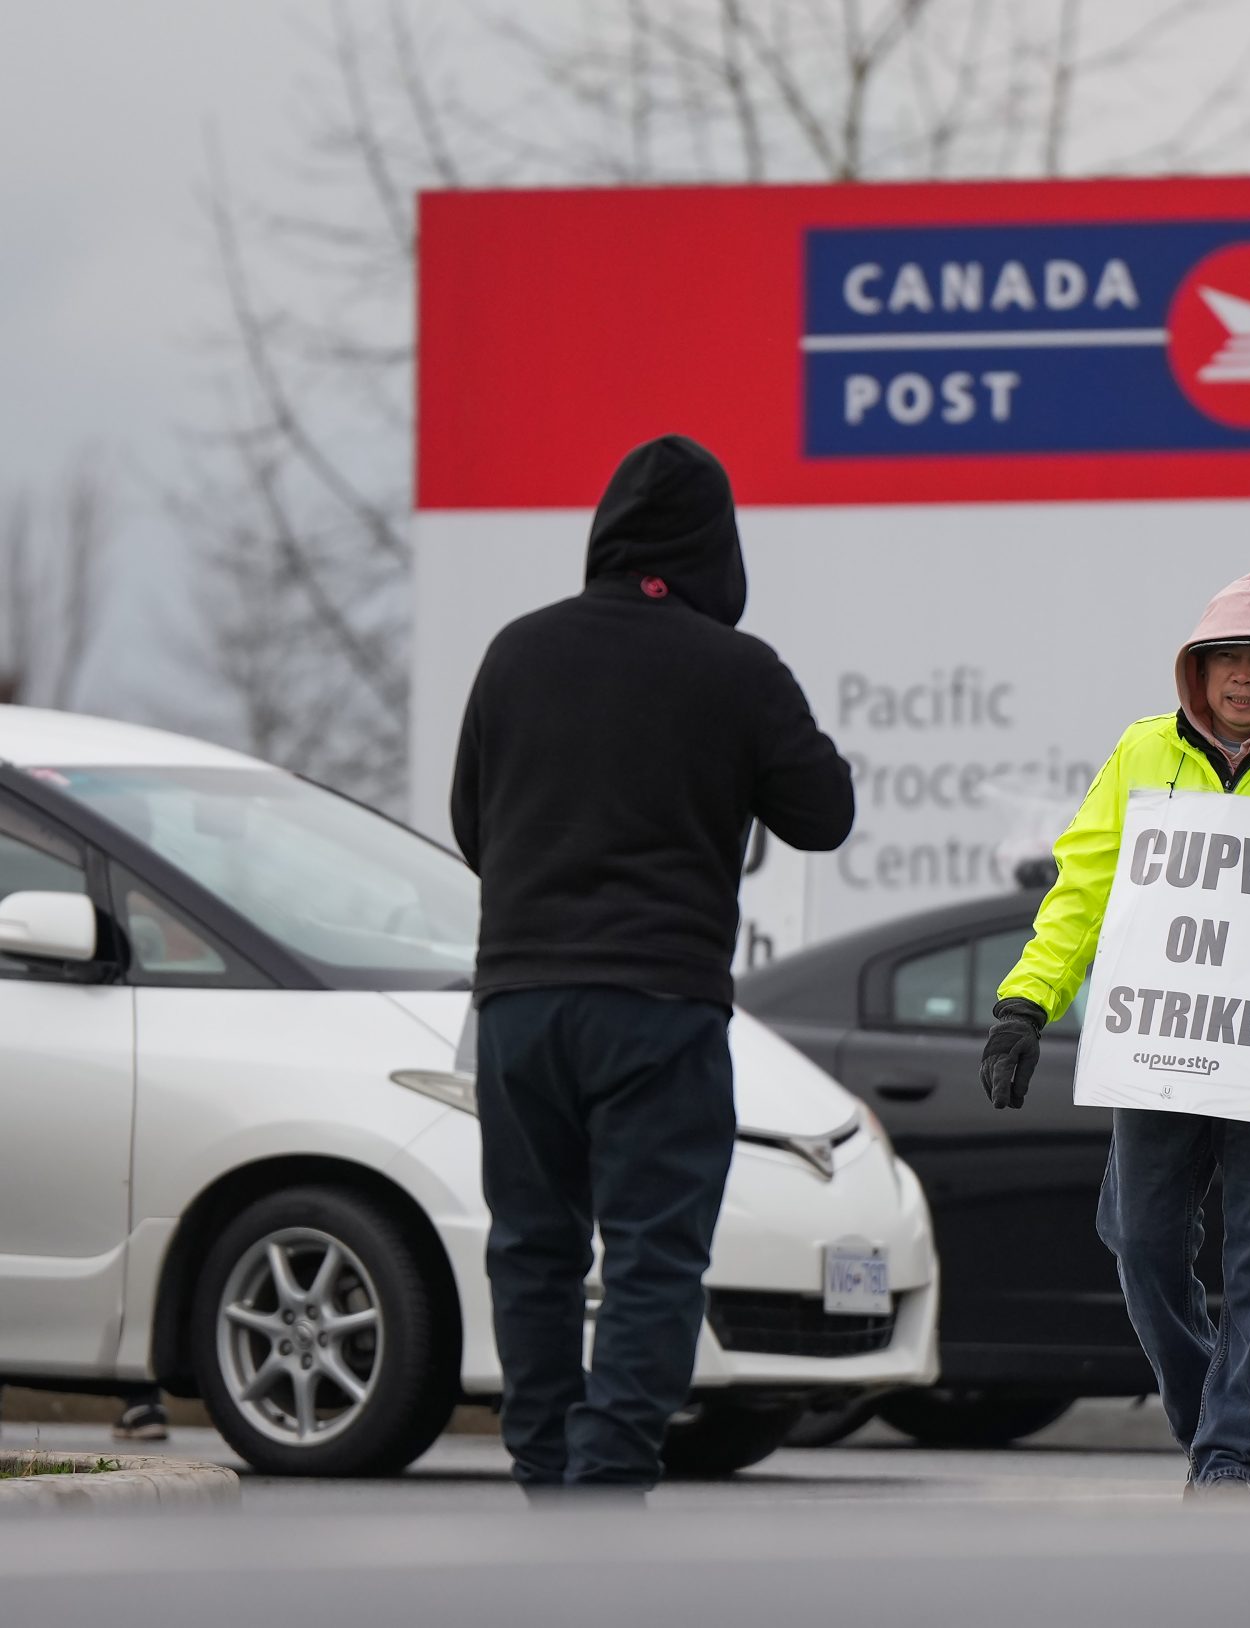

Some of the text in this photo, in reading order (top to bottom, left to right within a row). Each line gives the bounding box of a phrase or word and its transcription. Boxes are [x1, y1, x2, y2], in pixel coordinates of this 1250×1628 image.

[842, 258, 1139, 314] CANADA
[844, 372, 1020, 424] POST
[839, 667, 1014, 728] Pacific
[1165, 915, 1230, 967] ON
